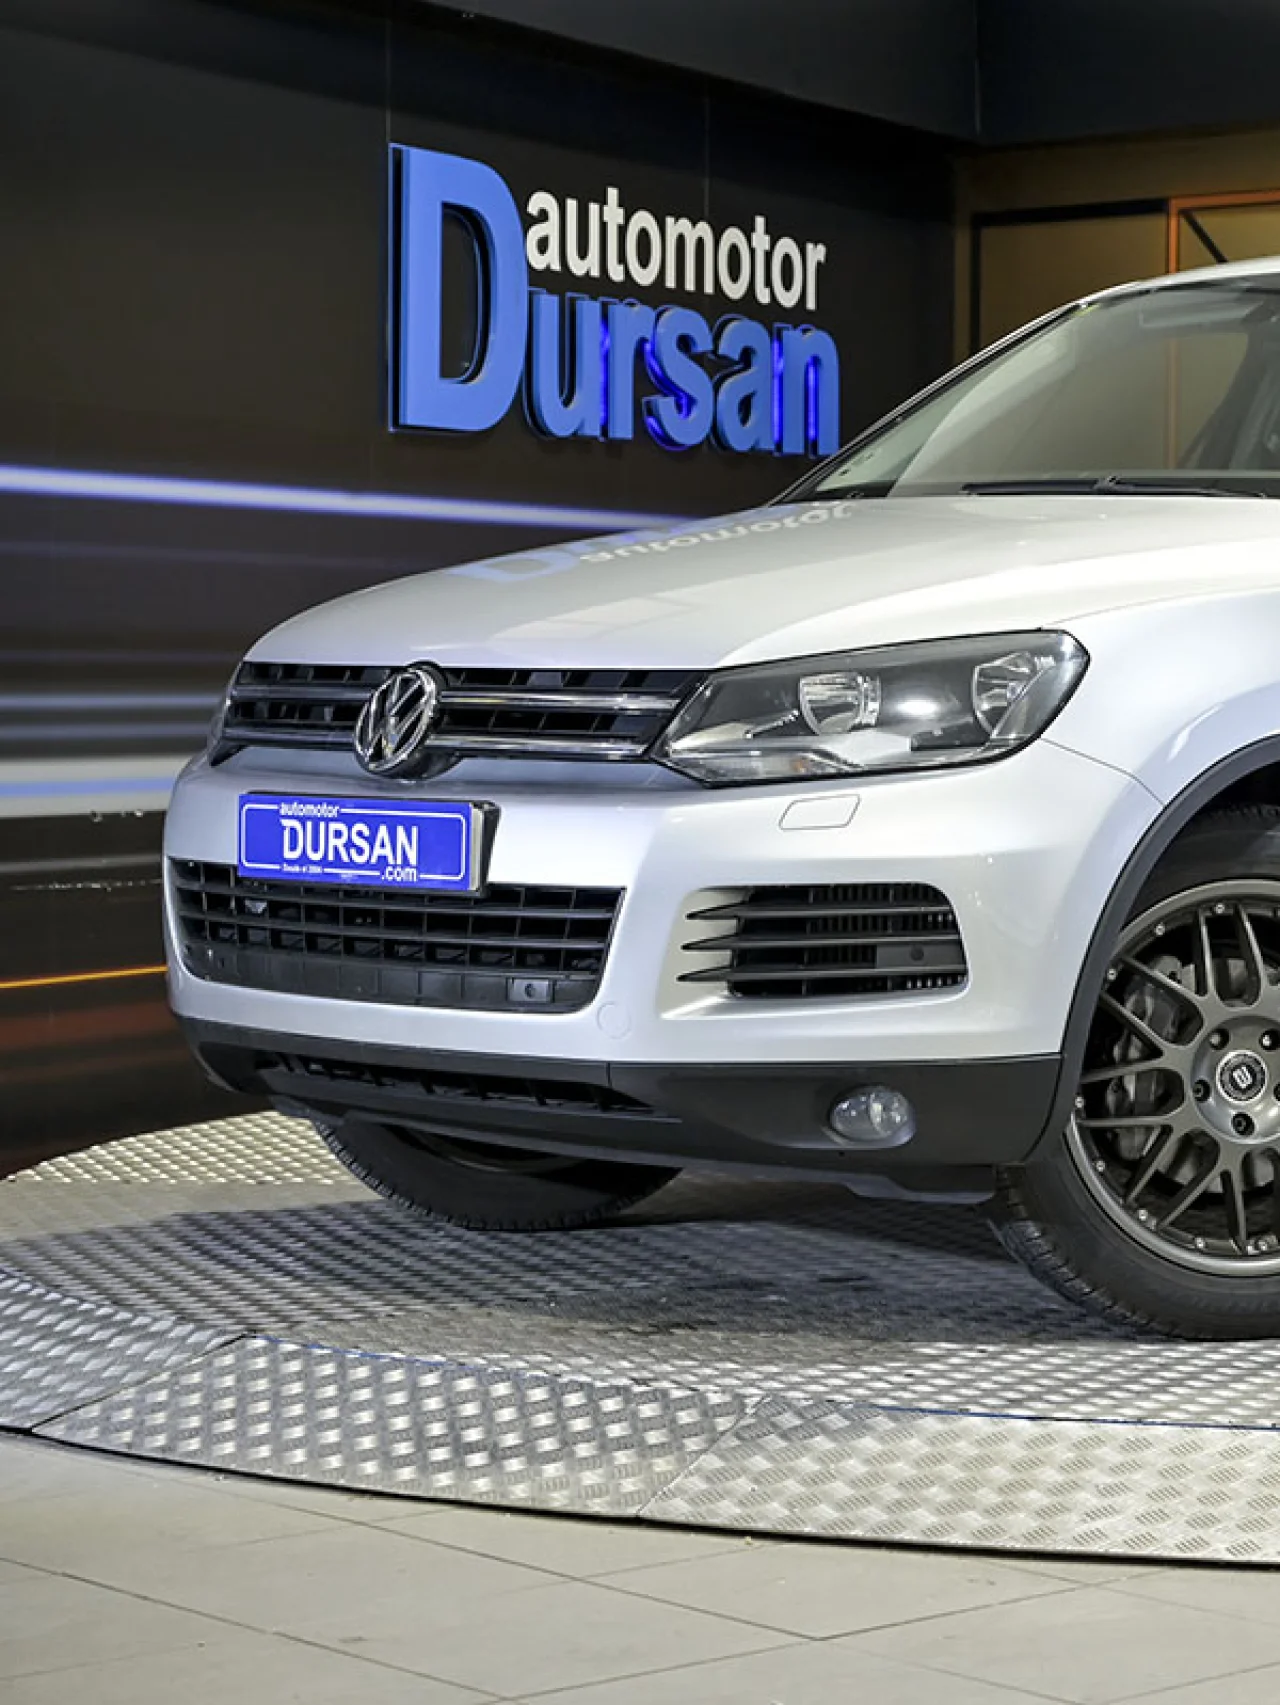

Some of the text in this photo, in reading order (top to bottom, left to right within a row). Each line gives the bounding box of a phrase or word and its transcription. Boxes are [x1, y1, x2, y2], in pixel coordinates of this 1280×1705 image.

[526, 186, 828, 310] automotor
[389, 143, 840, 458] Dursan
[279, 801, 341, 818] automotor
[279, 818, 419, 866] DURSAN
[381, 866, 418, 882] .com
